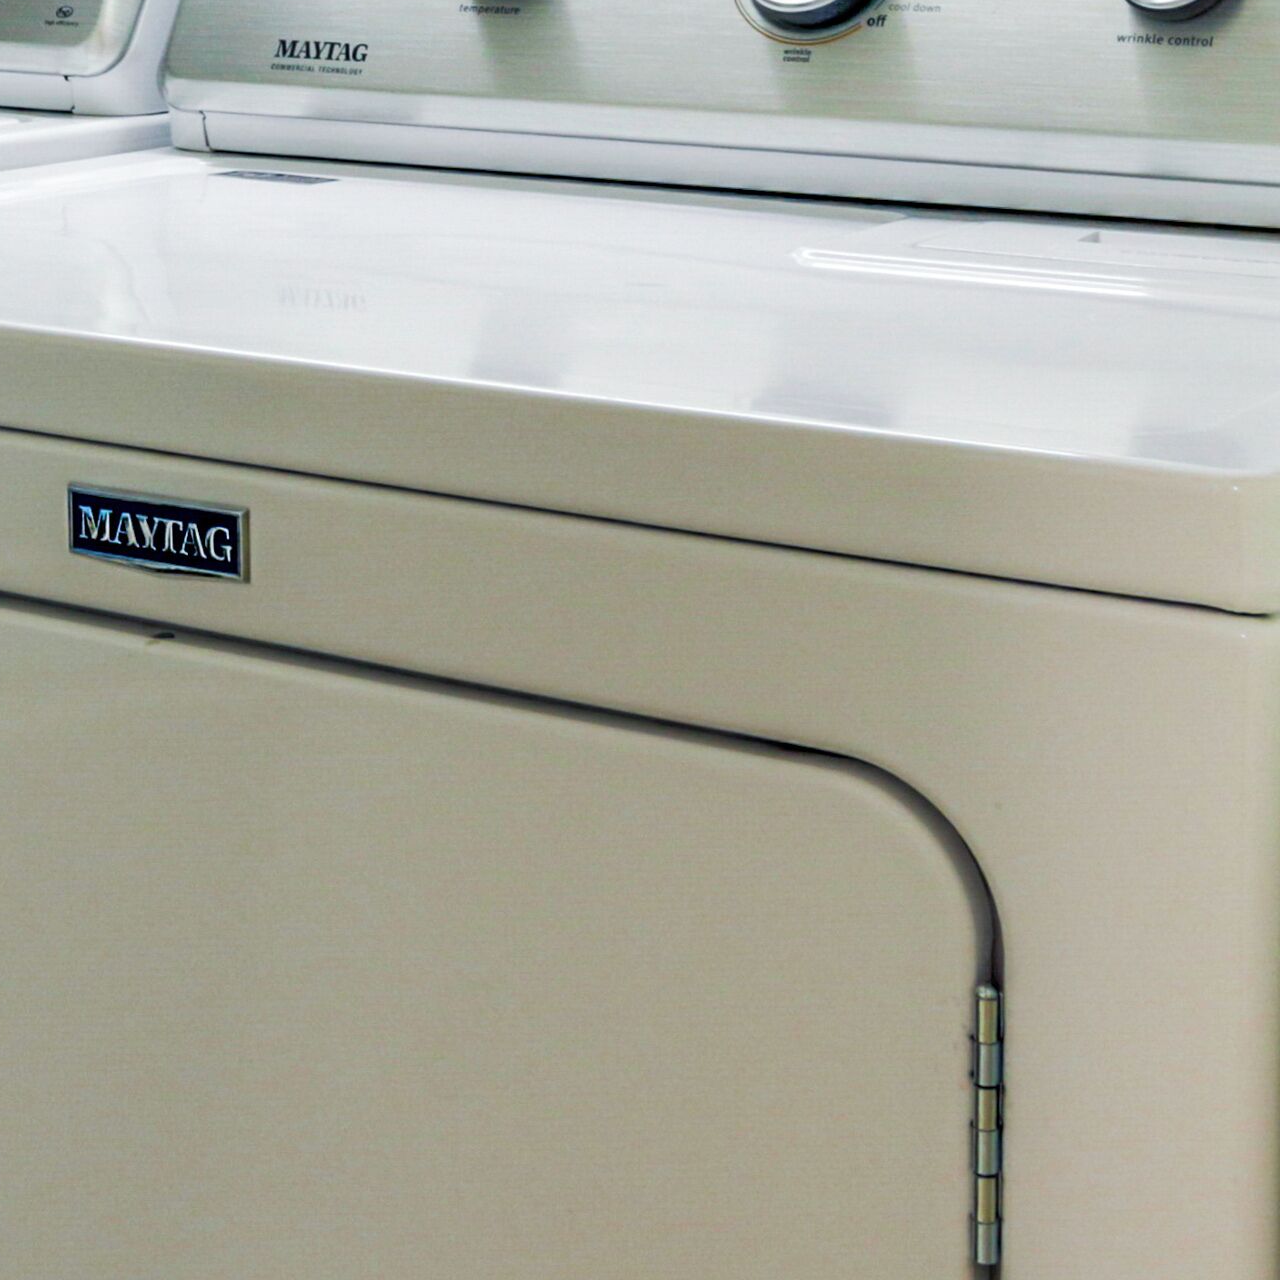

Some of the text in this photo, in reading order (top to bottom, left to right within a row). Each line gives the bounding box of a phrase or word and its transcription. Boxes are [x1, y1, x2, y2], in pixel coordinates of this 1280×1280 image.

[459, 4, 521, 15] temperature
[888, 3, 941, 12] cool down
[867, 15, 887, 27] off
[1117, 33, 1214, 47] wrinkle control
[274, 39, 369, 62] MAYTAG
[270, 63, 363, 75] COMMERCIAL TECHNOLOGY
[78, 504, 234, 562] MAYTAG
